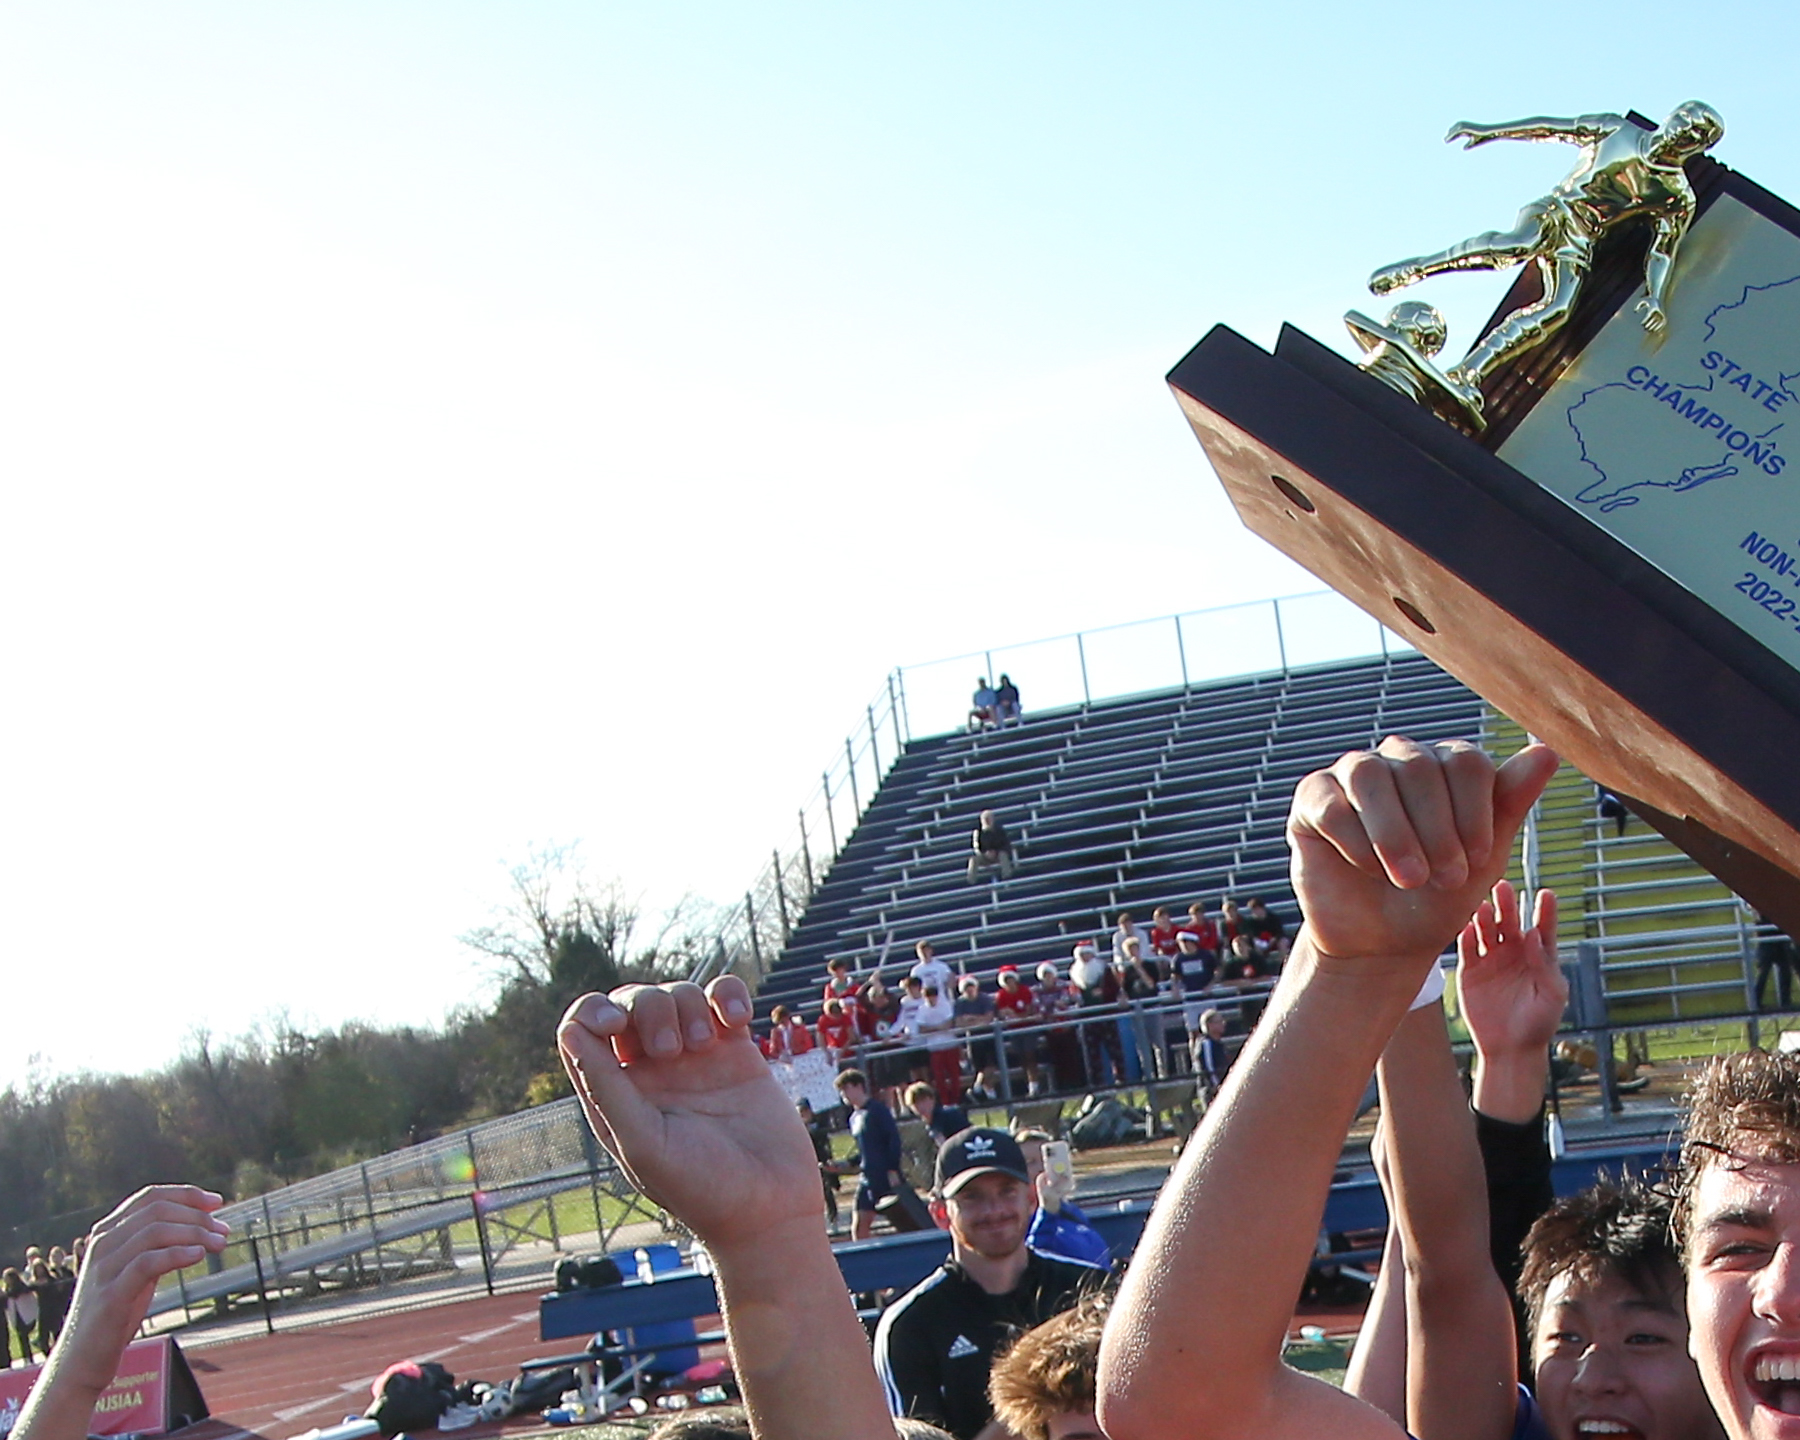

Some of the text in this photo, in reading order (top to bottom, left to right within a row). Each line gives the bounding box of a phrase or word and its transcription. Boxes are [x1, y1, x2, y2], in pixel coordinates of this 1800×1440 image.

[1700, 350, 1788, 413] STATE
[1626, 365, 1787, 476] CHAMPIONS
[95, 1391, 143, 1414] NJSIAA
